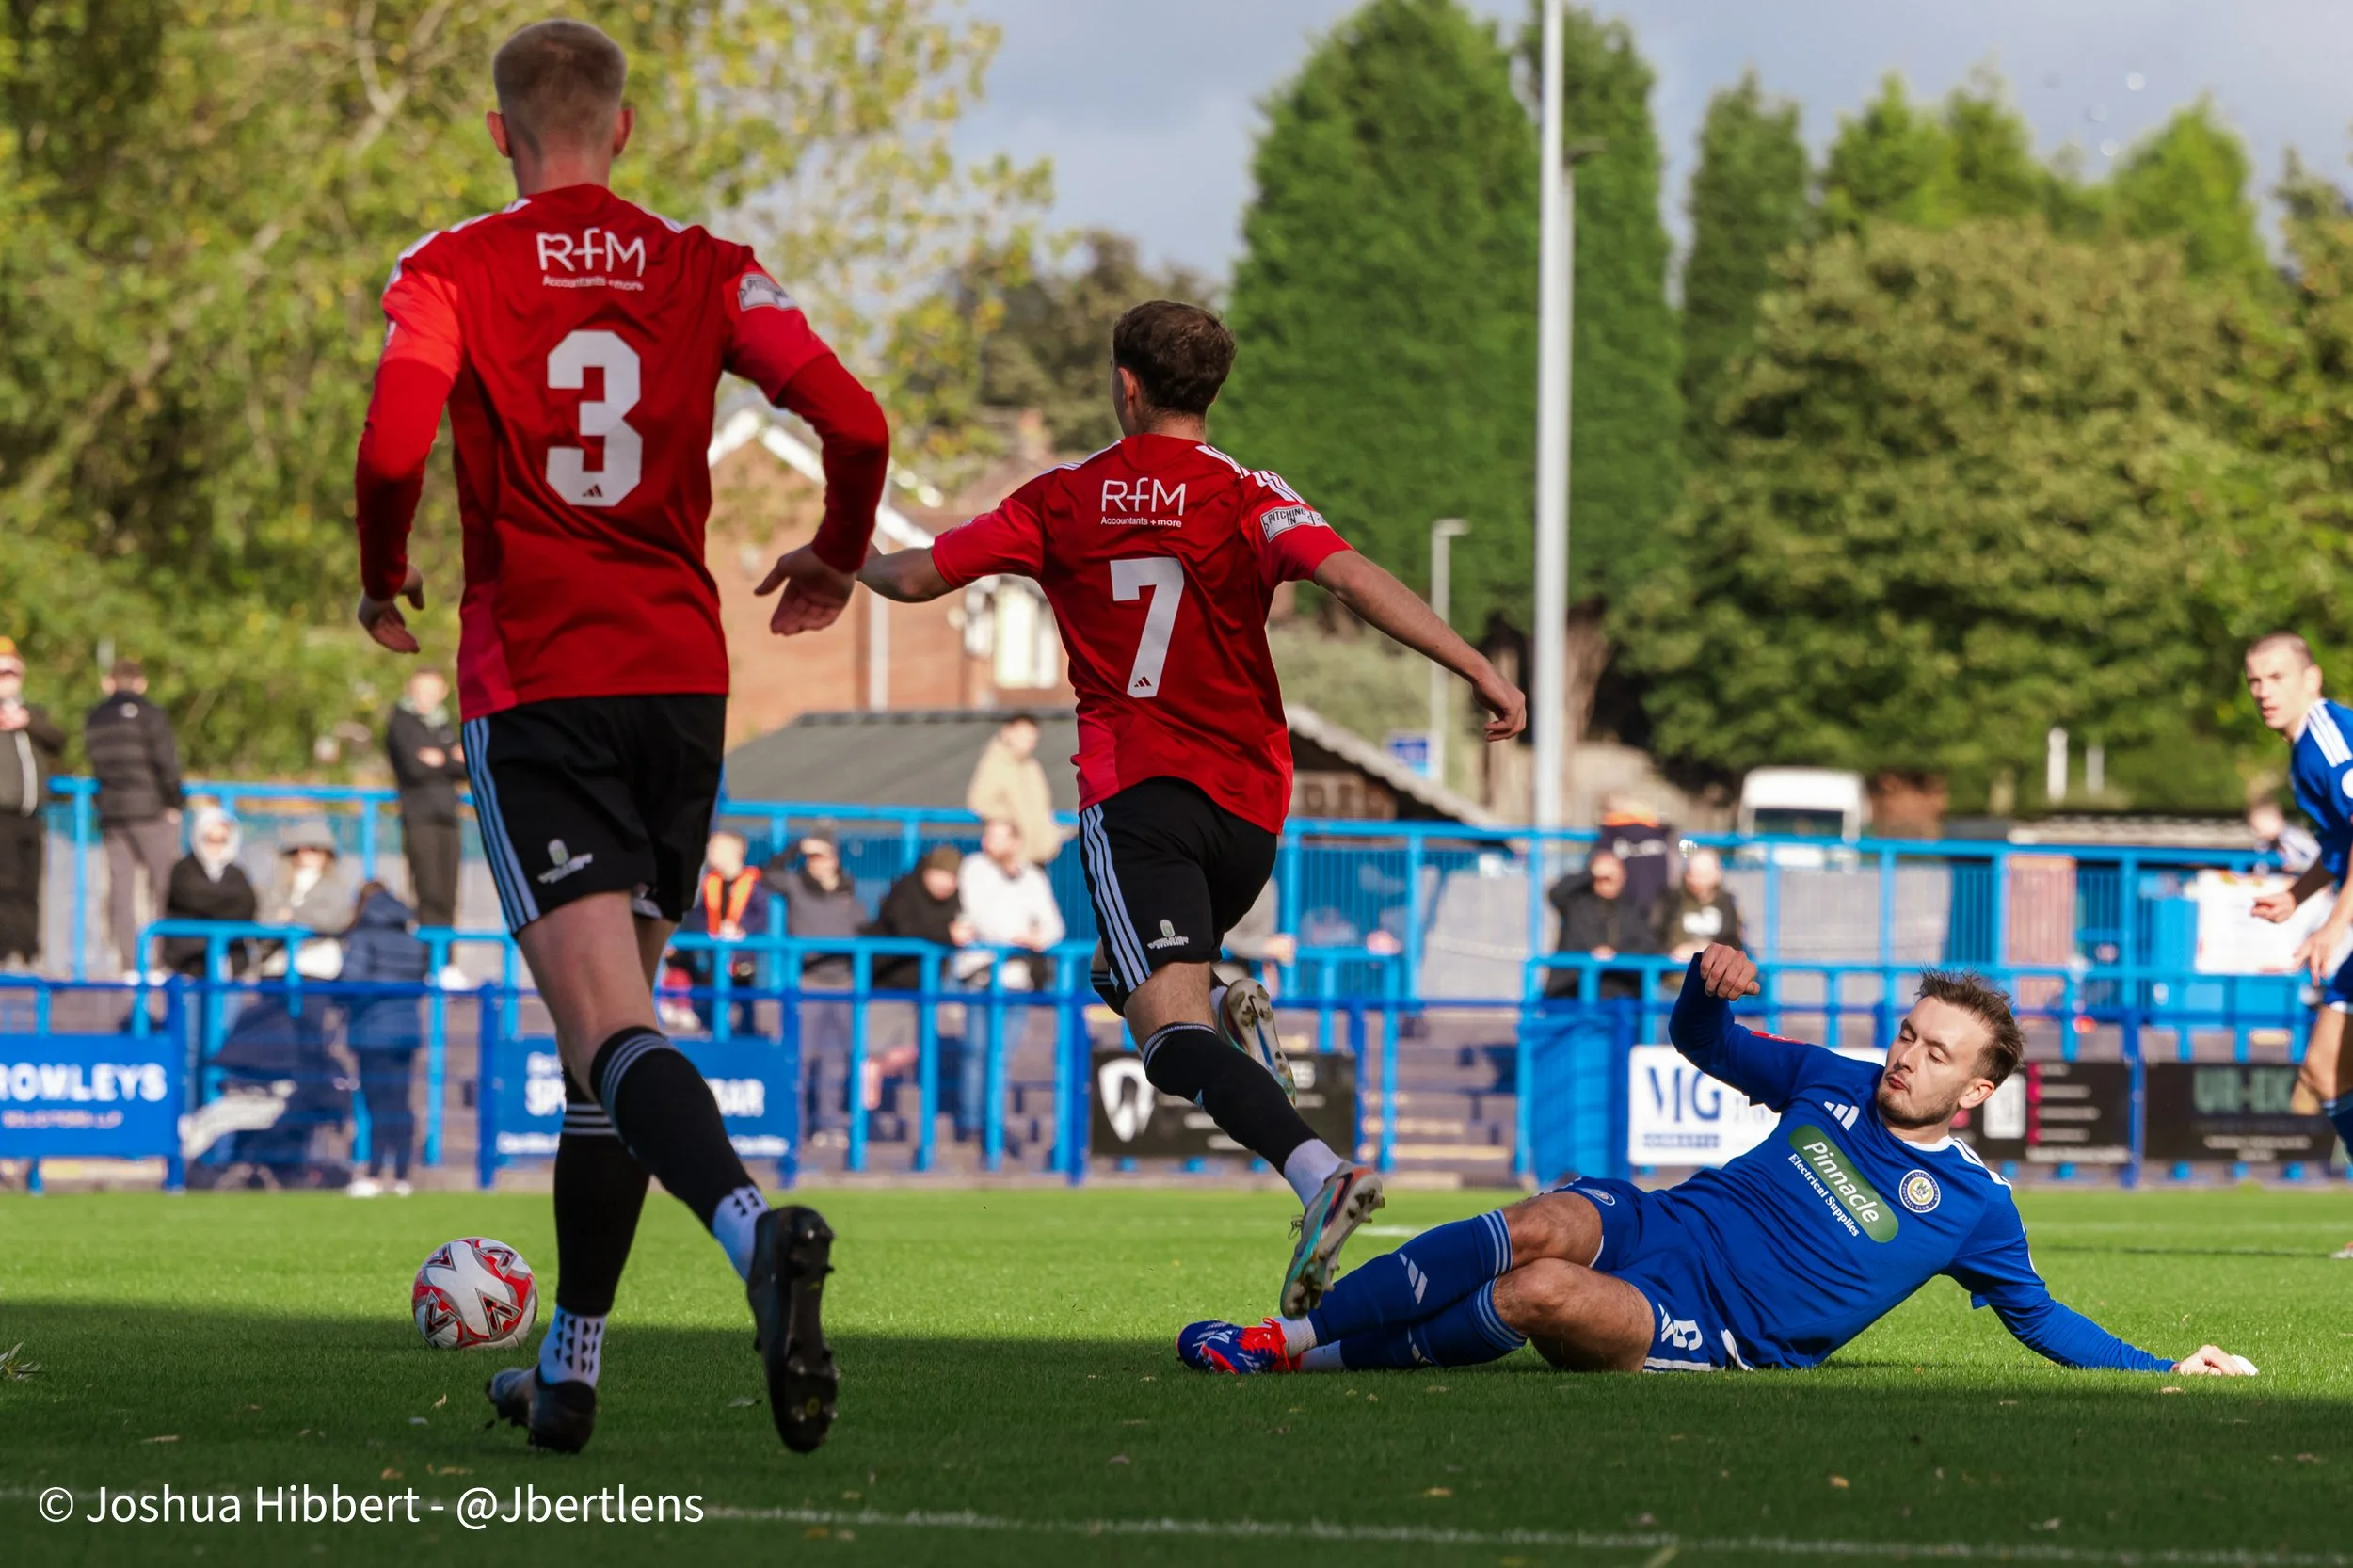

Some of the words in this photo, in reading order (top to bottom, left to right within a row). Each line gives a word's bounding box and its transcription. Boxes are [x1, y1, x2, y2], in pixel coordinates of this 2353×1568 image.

[546, 330, 642, 506] 3
[1100, 516, 1148, 525] Accountants
[1288, 516, 1296, 526] IN
[1110, 557, 1184, 697] 7
[1788, 1153, 1829, 1198] Electrical
[1825, 1195, 1860, 1237] Supplies
[1803, 1141, 1880, 1224] Pinnacle
